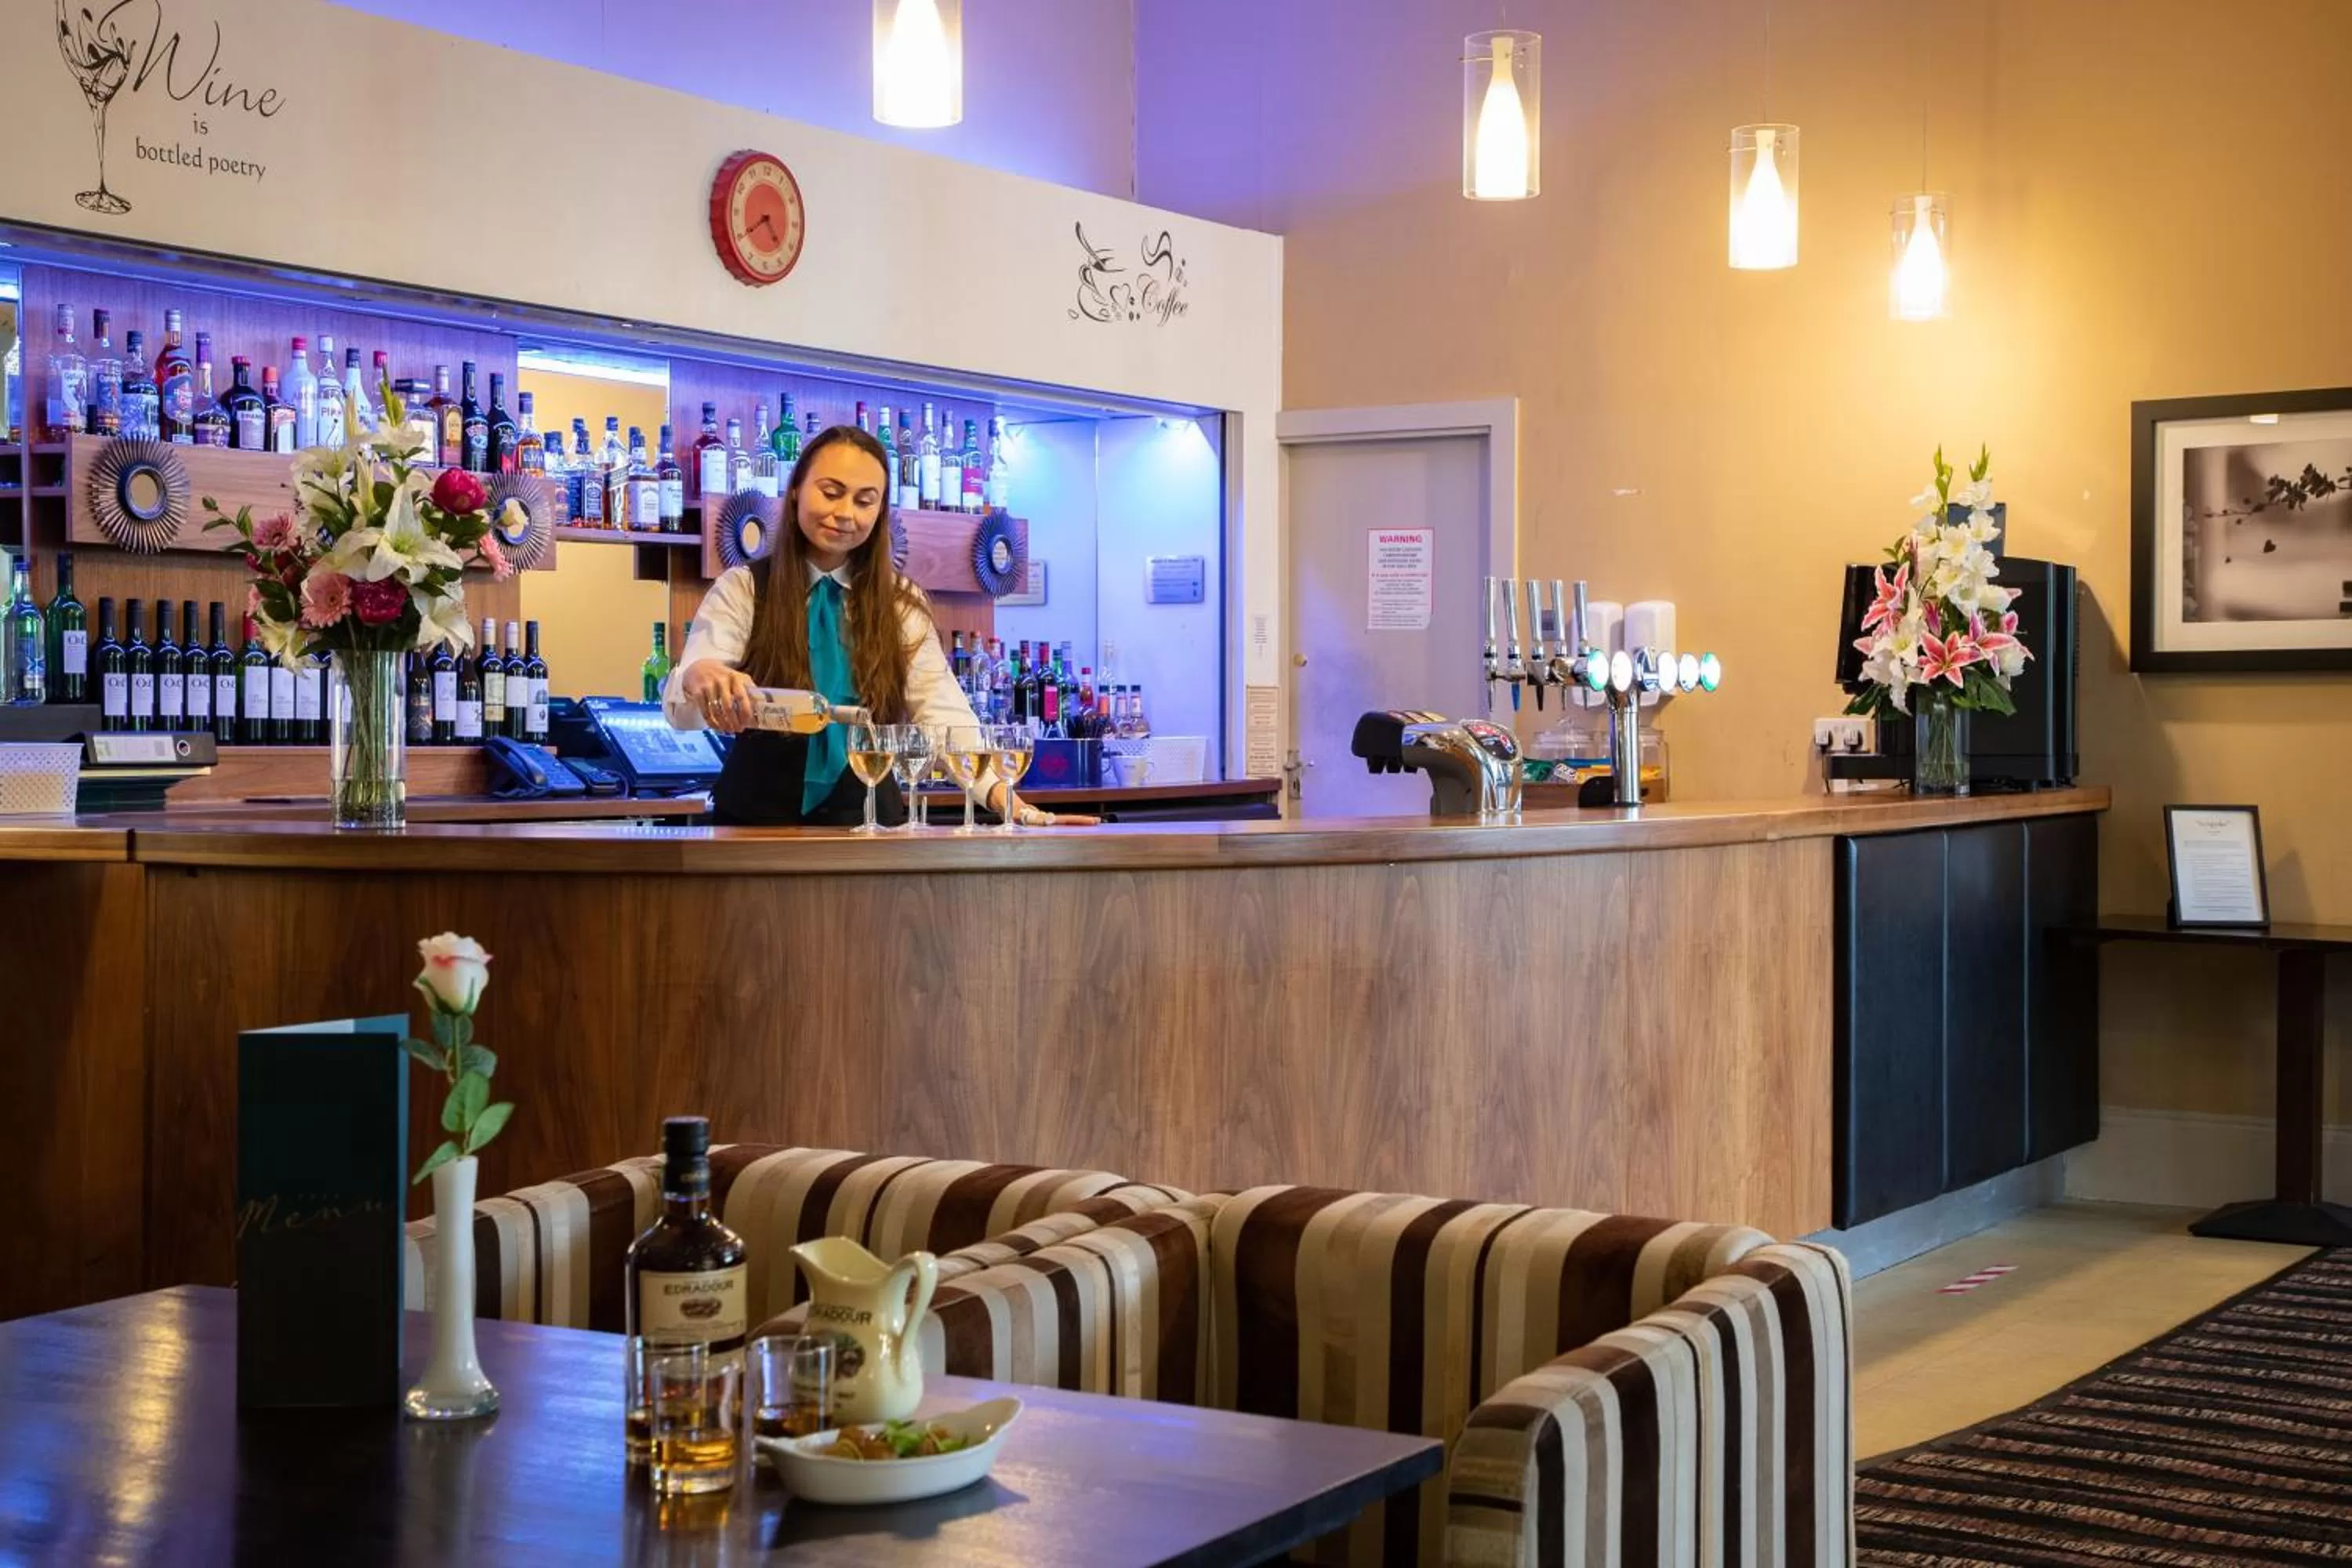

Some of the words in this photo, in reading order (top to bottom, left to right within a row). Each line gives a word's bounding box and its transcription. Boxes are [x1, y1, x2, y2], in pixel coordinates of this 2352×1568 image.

[98, 0, 287, 117] Wine
[192, 113, 209, 135] is
[136, 136, 203, 168] bottled
[209, 155, 267, 183] poetry
[763, 165, 772, 176] 12
[1137, 273, 1188, 326] Coffee
[1379, 535, 1423, 543] WARNING
[236, 1193, 384, 1239] Menu
